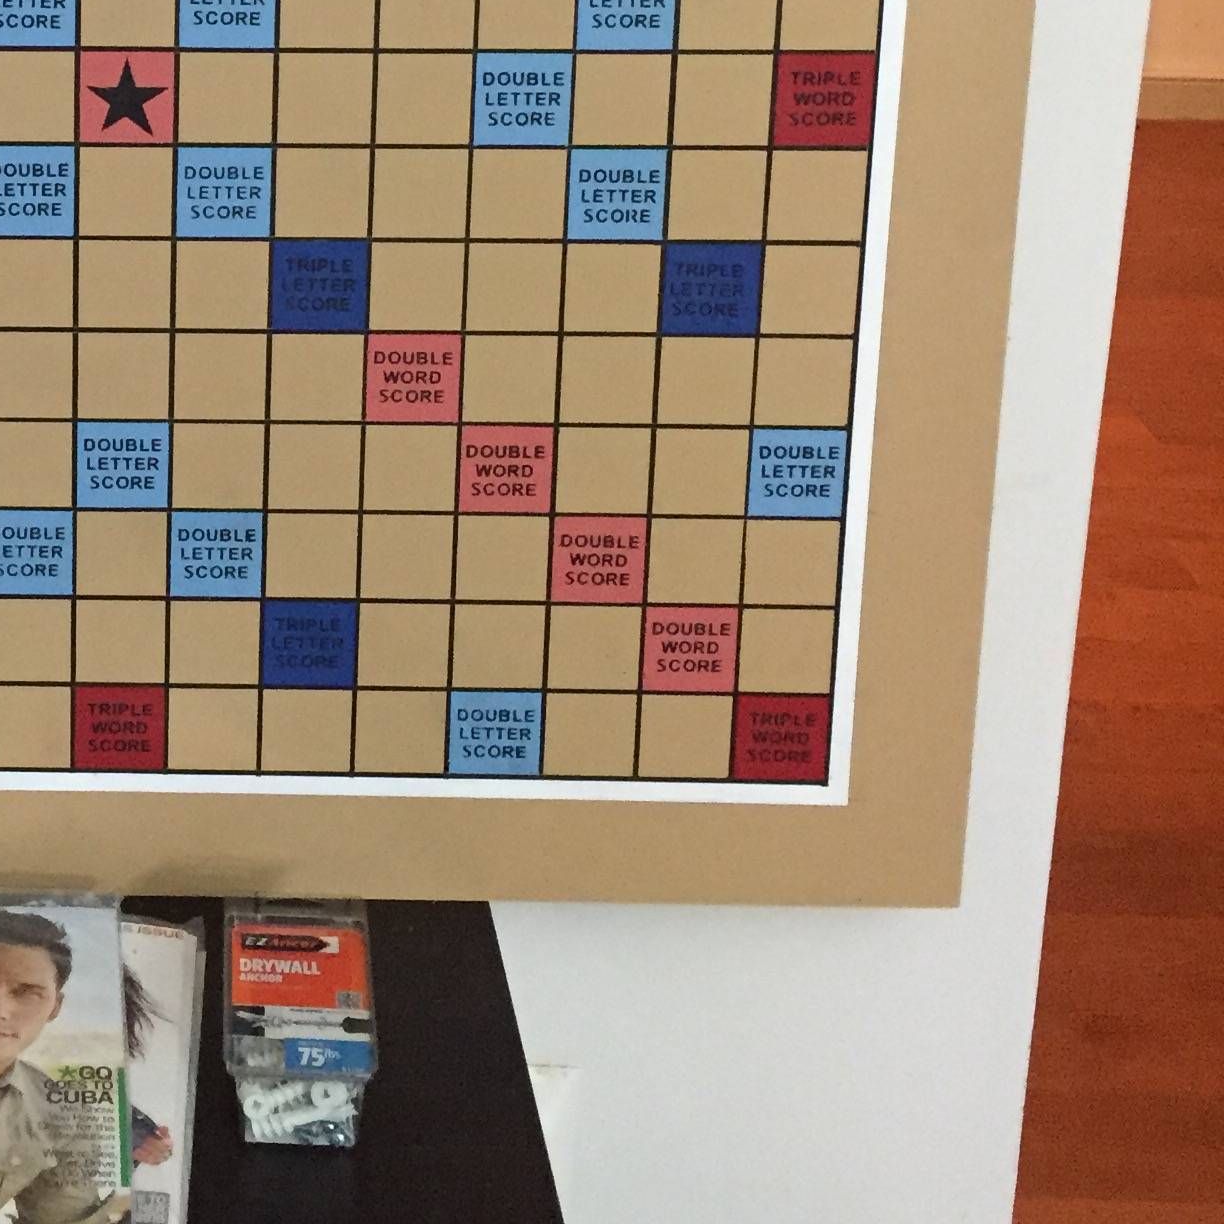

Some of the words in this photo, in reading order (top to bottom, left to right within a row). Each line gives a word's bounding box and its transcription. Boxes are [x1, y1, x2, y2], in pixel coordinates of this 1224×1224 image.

[193, 10, 260, 26] SCORE
[482, 71, 564, 87] DOUBLE
[484, 91, 561, 107] LETTER
[487, 111, 554, 126] SCORE
[373, 351, 453, 366] DOUBLE
[383, 370, 441, 385] WORD
[379, 389, 444, 404] SCORE
[83, 438, 161, 452] DOUBLE
[758, 445, 840, 460] DOUBLE
[86, 456, 159, 471] LETTER
[761, 464, 836, 479] LETTER
[90, 475, 155, 490] SCORE
[763, 483, 830, 498] SCORE
[177, 528, 256, 542] DOUBLE
[180, 546, 253, 561] LETTER
[184, 565, 248, 579] SCORE
[651, 621, 730, 636] DOUBLE
[661, 640, 719, 654] WORD
[656, 658, 721, 673] SCORE
[87, 701, 152, 717] TRIPLE
[91, 720, 148, 735] WORD
[88, 738, 151, 752] SCORE
[239, 958, 321, 975] DRYWALL
[297, 1046, 327, 1067] 75
[78, 1065, 113, 1080] GQ
[93, 1080, 114, 1090] TO
[45, 1090, 114, 1105] CUBA
